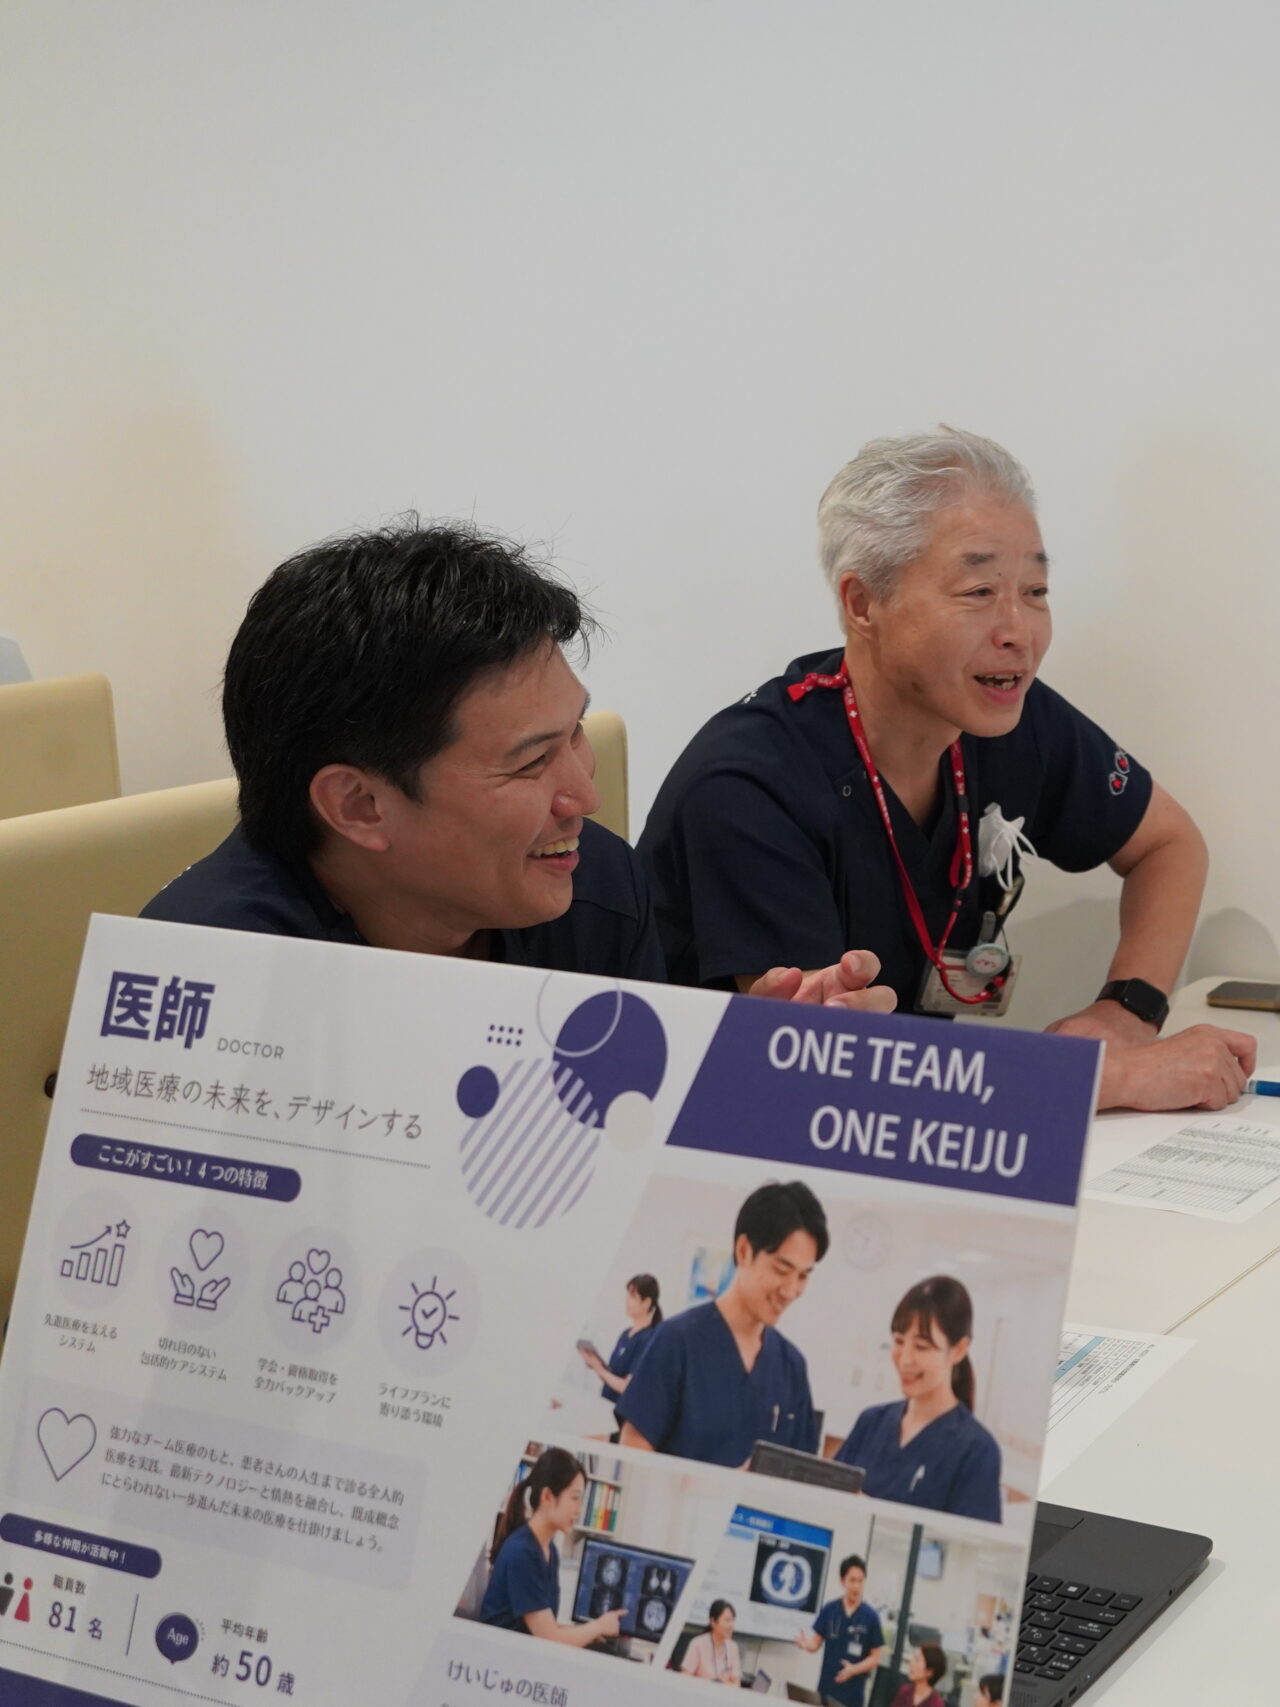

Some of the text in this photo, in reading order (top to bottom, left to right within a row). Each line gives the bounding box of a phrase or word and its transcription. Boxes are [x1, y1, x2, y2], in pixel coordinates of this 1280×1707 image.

[100, 970, 216, 1049] 医師
[217, 1037, 285, 1060] DOCTOR
[768, 1026, 995, 1104] ONE TEAM,
[86, 1063, 423, 1140] 地域医療の未来を、デザインする
[809, 1105, 900, 1160] ONE
[908, 1119, 1028, 1178] KEIJU
[59, 1335, 96, 1353] システム
[157, 1337, 217, 1360] 切れ目のない
[167, 1627, 189, 1646] Age
[221, 1618, 269, 1644] 平均年齢
[448, 1660, 568, 1707] けいじゅの医師
